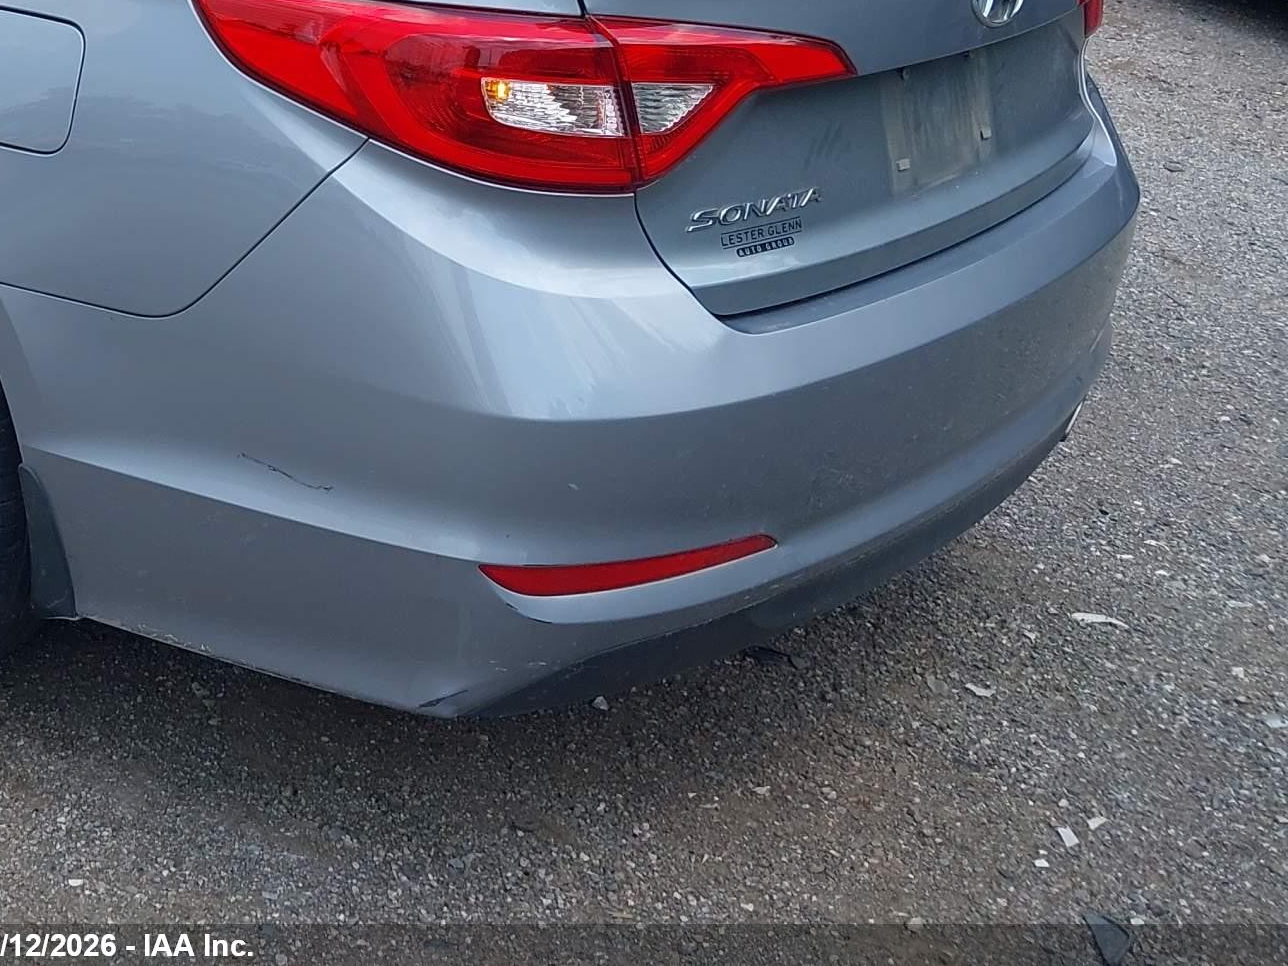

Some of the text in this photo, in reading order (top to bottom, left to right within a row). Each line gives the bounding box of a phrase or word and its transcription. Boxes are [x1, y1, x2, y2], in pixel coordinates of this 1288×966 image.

[685, 186, 823, 233] SONATA
[720, 218, 803, 247] LESTER GLENN
[738, 237, 794, 256] AUTO GROUP
